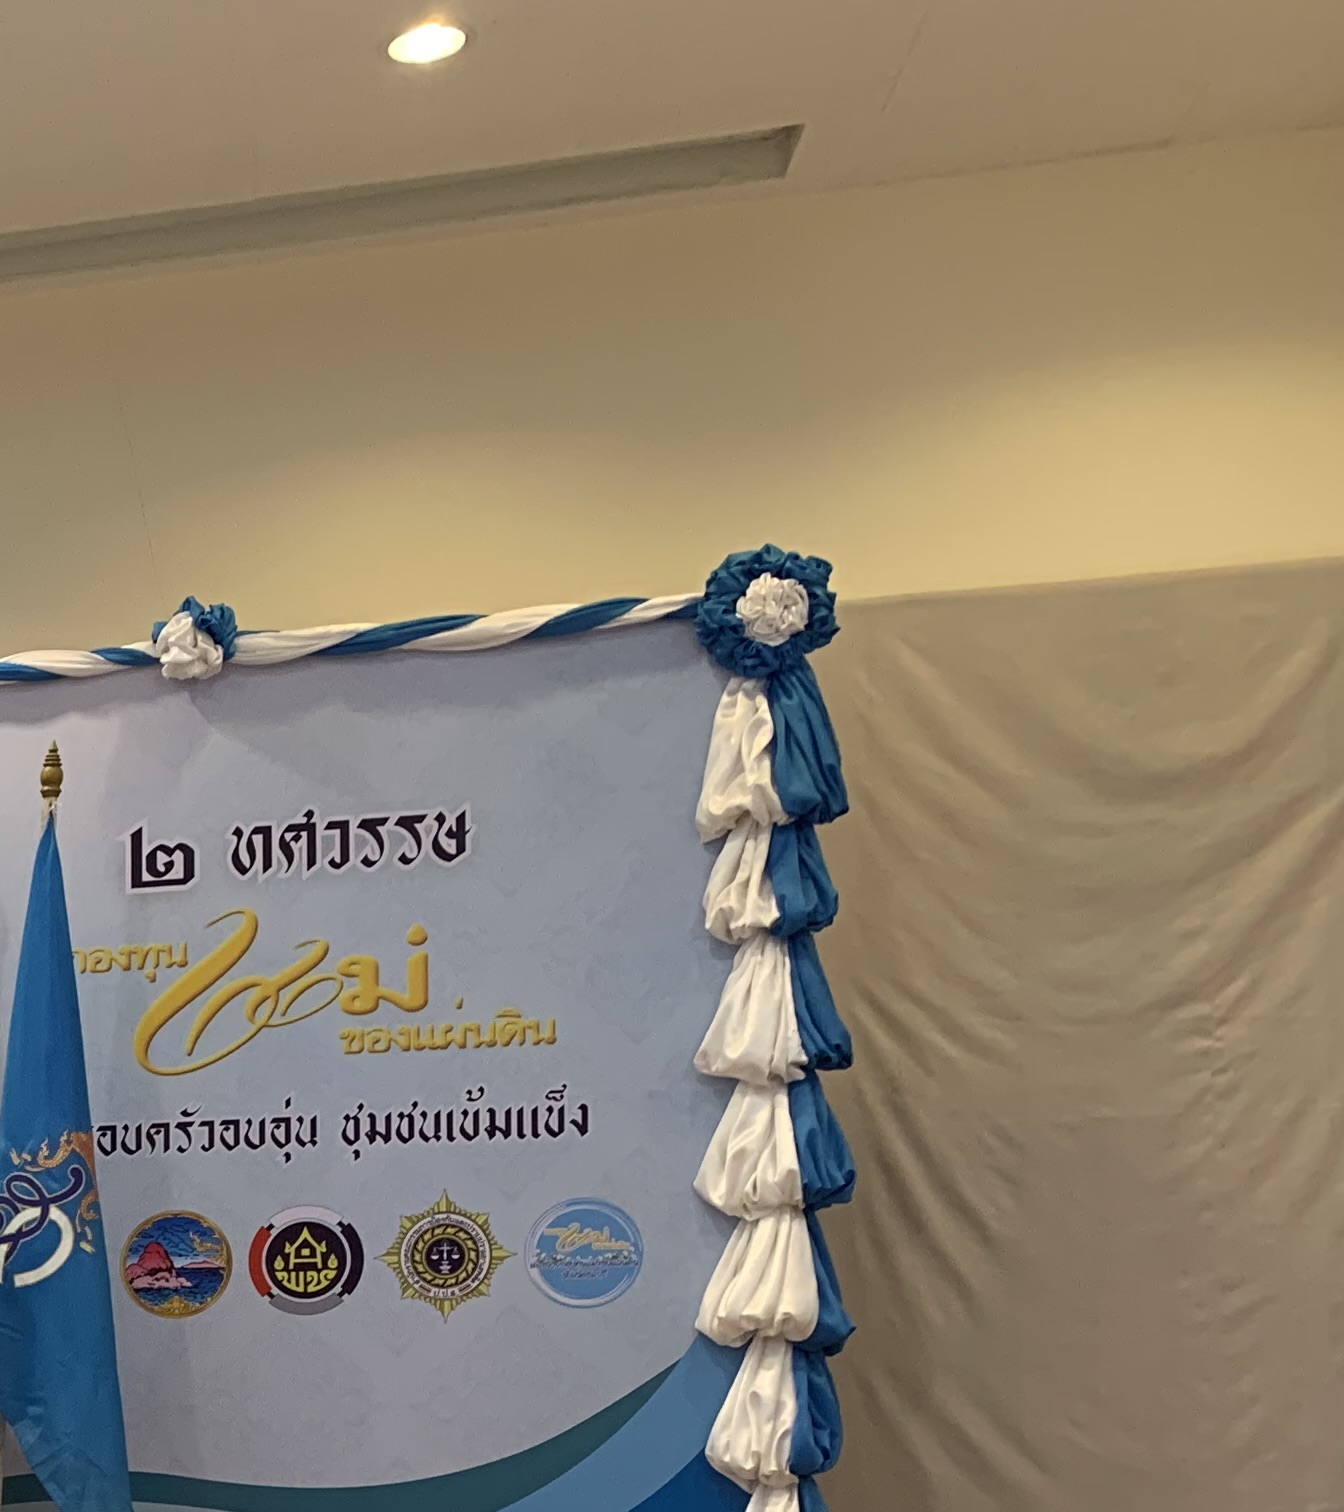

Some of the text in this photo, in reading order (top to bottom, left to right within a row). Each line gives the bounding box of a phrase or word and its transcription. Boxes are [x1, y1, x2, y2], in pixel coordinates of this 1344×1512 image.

[129, 808, 473, 889] ๒ ทศวรรษ
[338, 996, 558, 1056] ของแผ่นดิน
[94, 1084, 590, 1165] อบครัวอบอุ่น ชุมชนเข้มแข็ง
